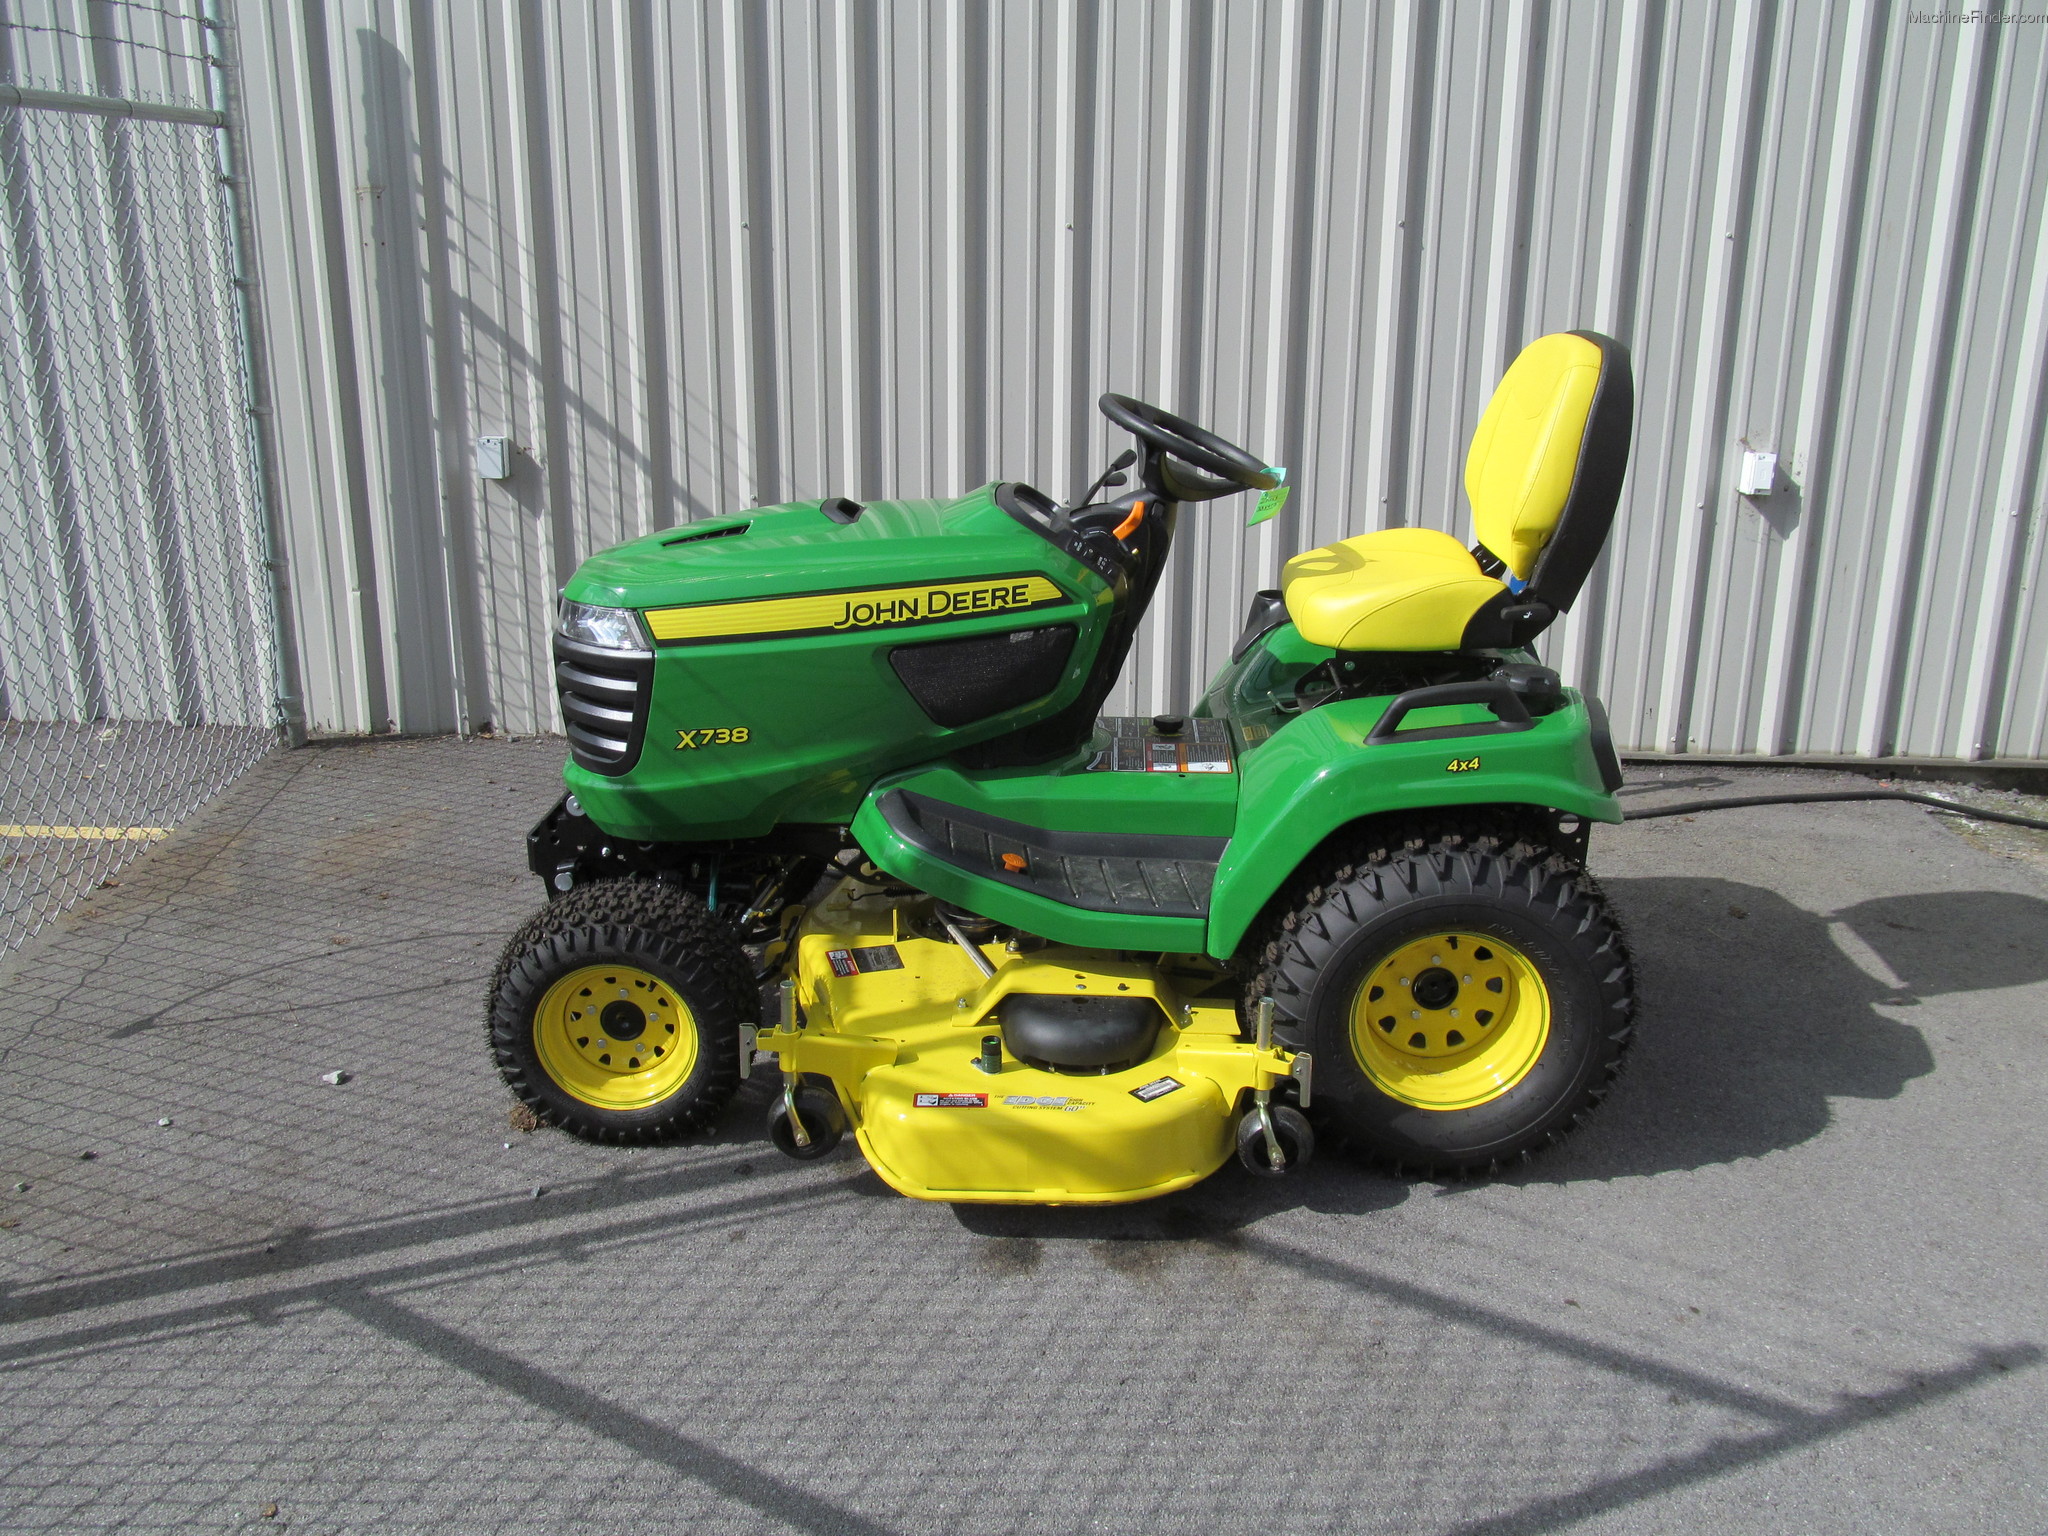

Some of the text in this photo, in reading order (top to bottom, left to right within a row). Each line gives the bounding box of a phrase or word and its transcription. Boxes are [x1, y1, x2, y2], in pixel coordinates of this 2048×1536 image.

[833, 584, 1030, 627] JOHN DEERE
[674, 726, 750, 750] X738
[1446, 756, 1480, 772] 4x4
